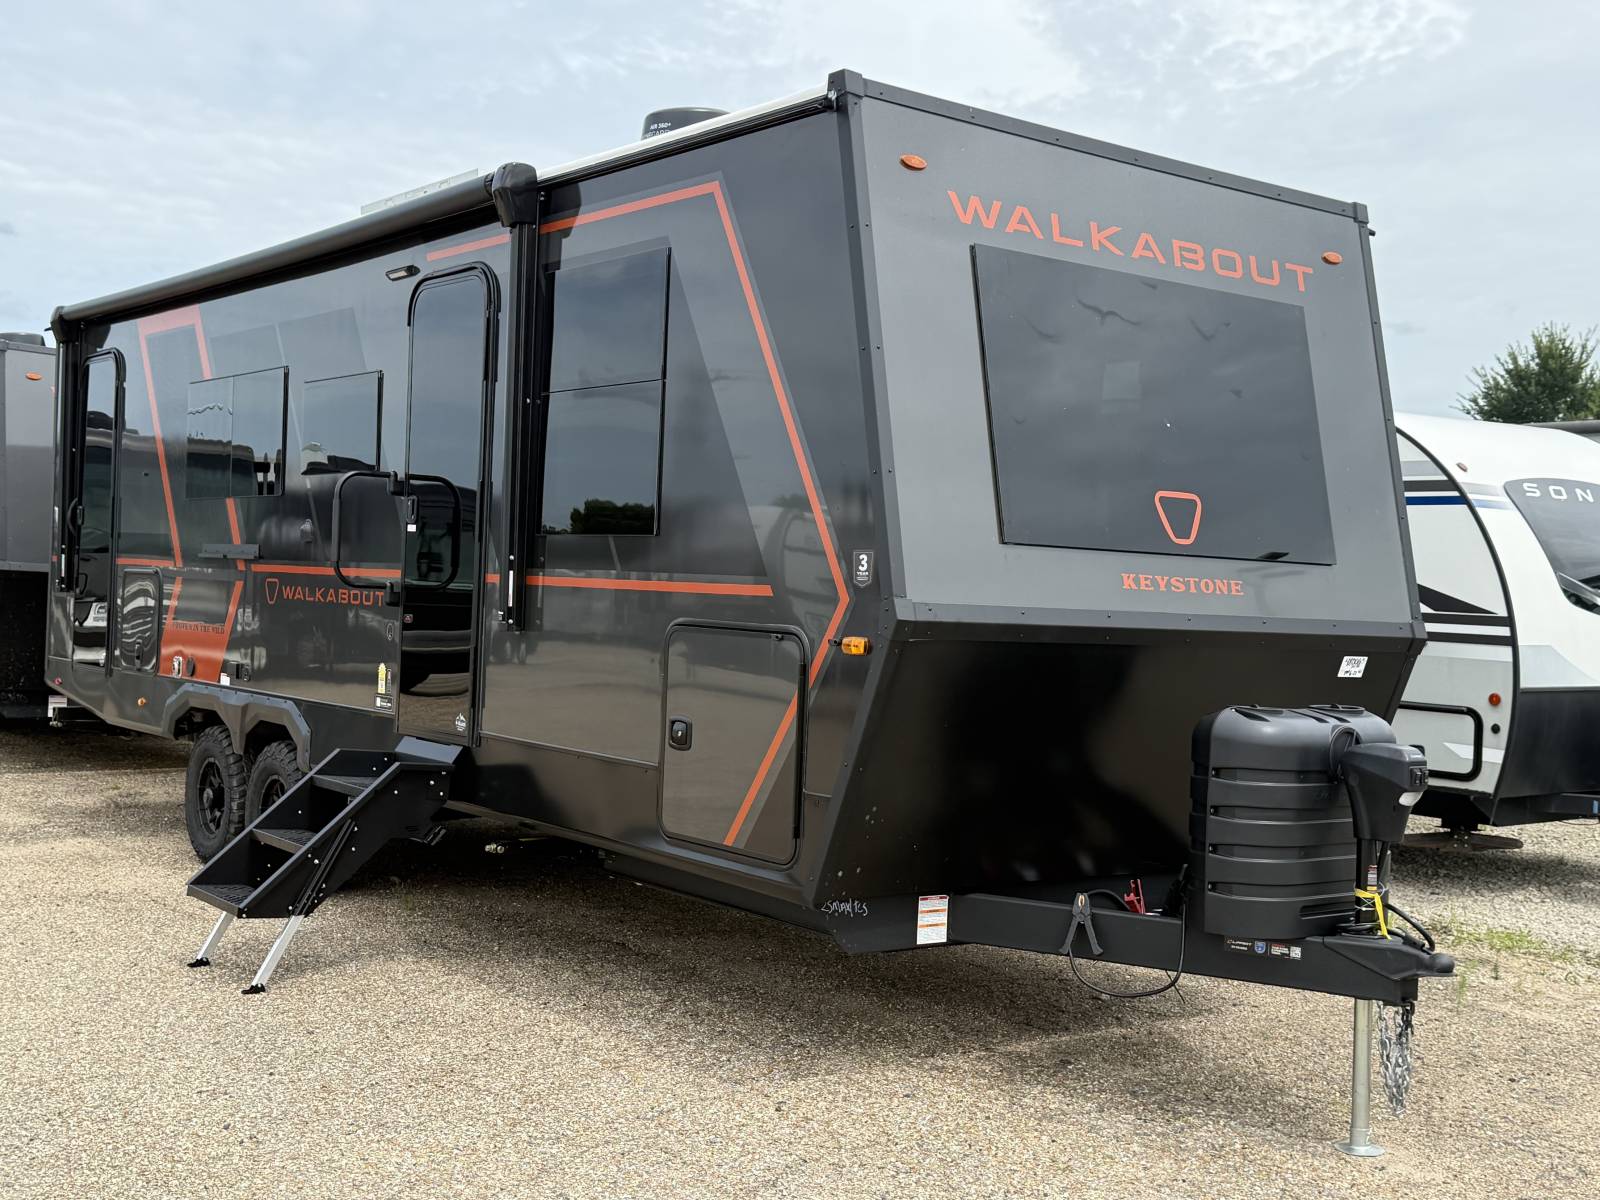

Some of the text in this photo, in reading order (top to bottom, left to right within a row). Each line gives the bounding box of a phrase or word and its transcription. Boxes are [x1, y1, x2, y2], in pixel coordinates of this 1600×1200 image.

[947, 189, 1314, 292] WALKABOUT
[1522, 482, 1594, 503] SON
[858, 554, 868, 571] 3
[281, 584, 385, 608] WALKABOUT
[1120, 573, 1246, 597] KEYSTONE
